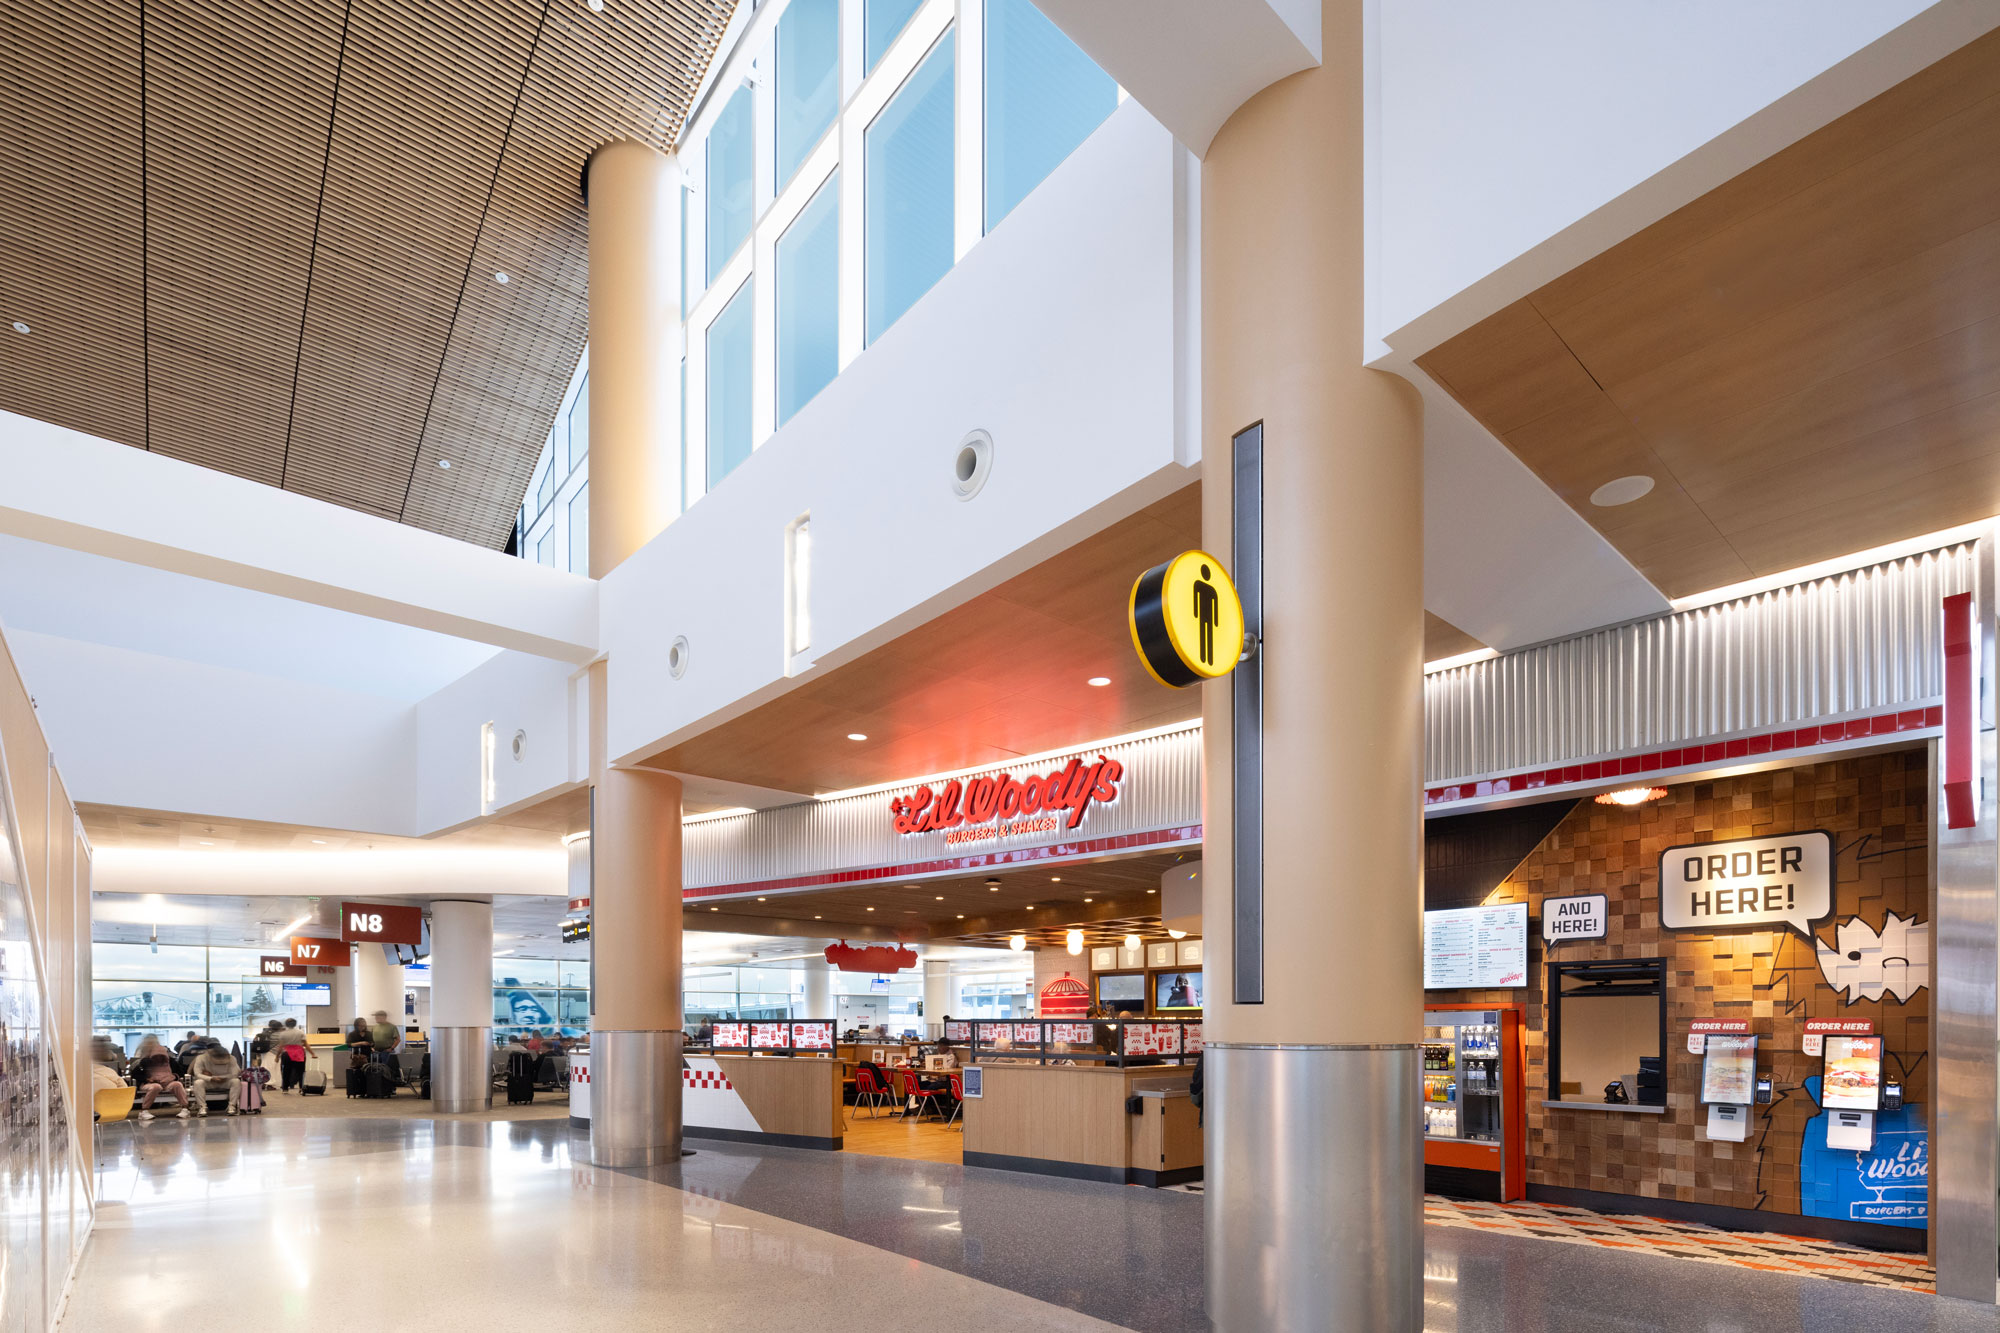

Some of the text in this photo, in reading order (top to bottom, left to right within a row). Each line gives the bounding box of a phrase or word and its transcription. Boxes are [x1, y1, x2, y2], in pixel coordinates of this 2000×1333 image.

[893, 755, 1124, 835] Lil Woody's
[946, 817, 1057, 845] BURGERS & SHAKES
[1683, 846, 1803, 882] ORDER
[1691, 883, 1795, 917] HERE!
[1558, 901, 1591, 917] AND
[350, 913, 383, 933] N8
[1552, 918, 1598, 934] HERE!
[297, 944, 321, 959] N7
[264, 961, 285, 973] N6
[1691, 1022, 1747, 1031] ORDER HERE
[1806, 1022, 1871, 1031] ORDER HERE
